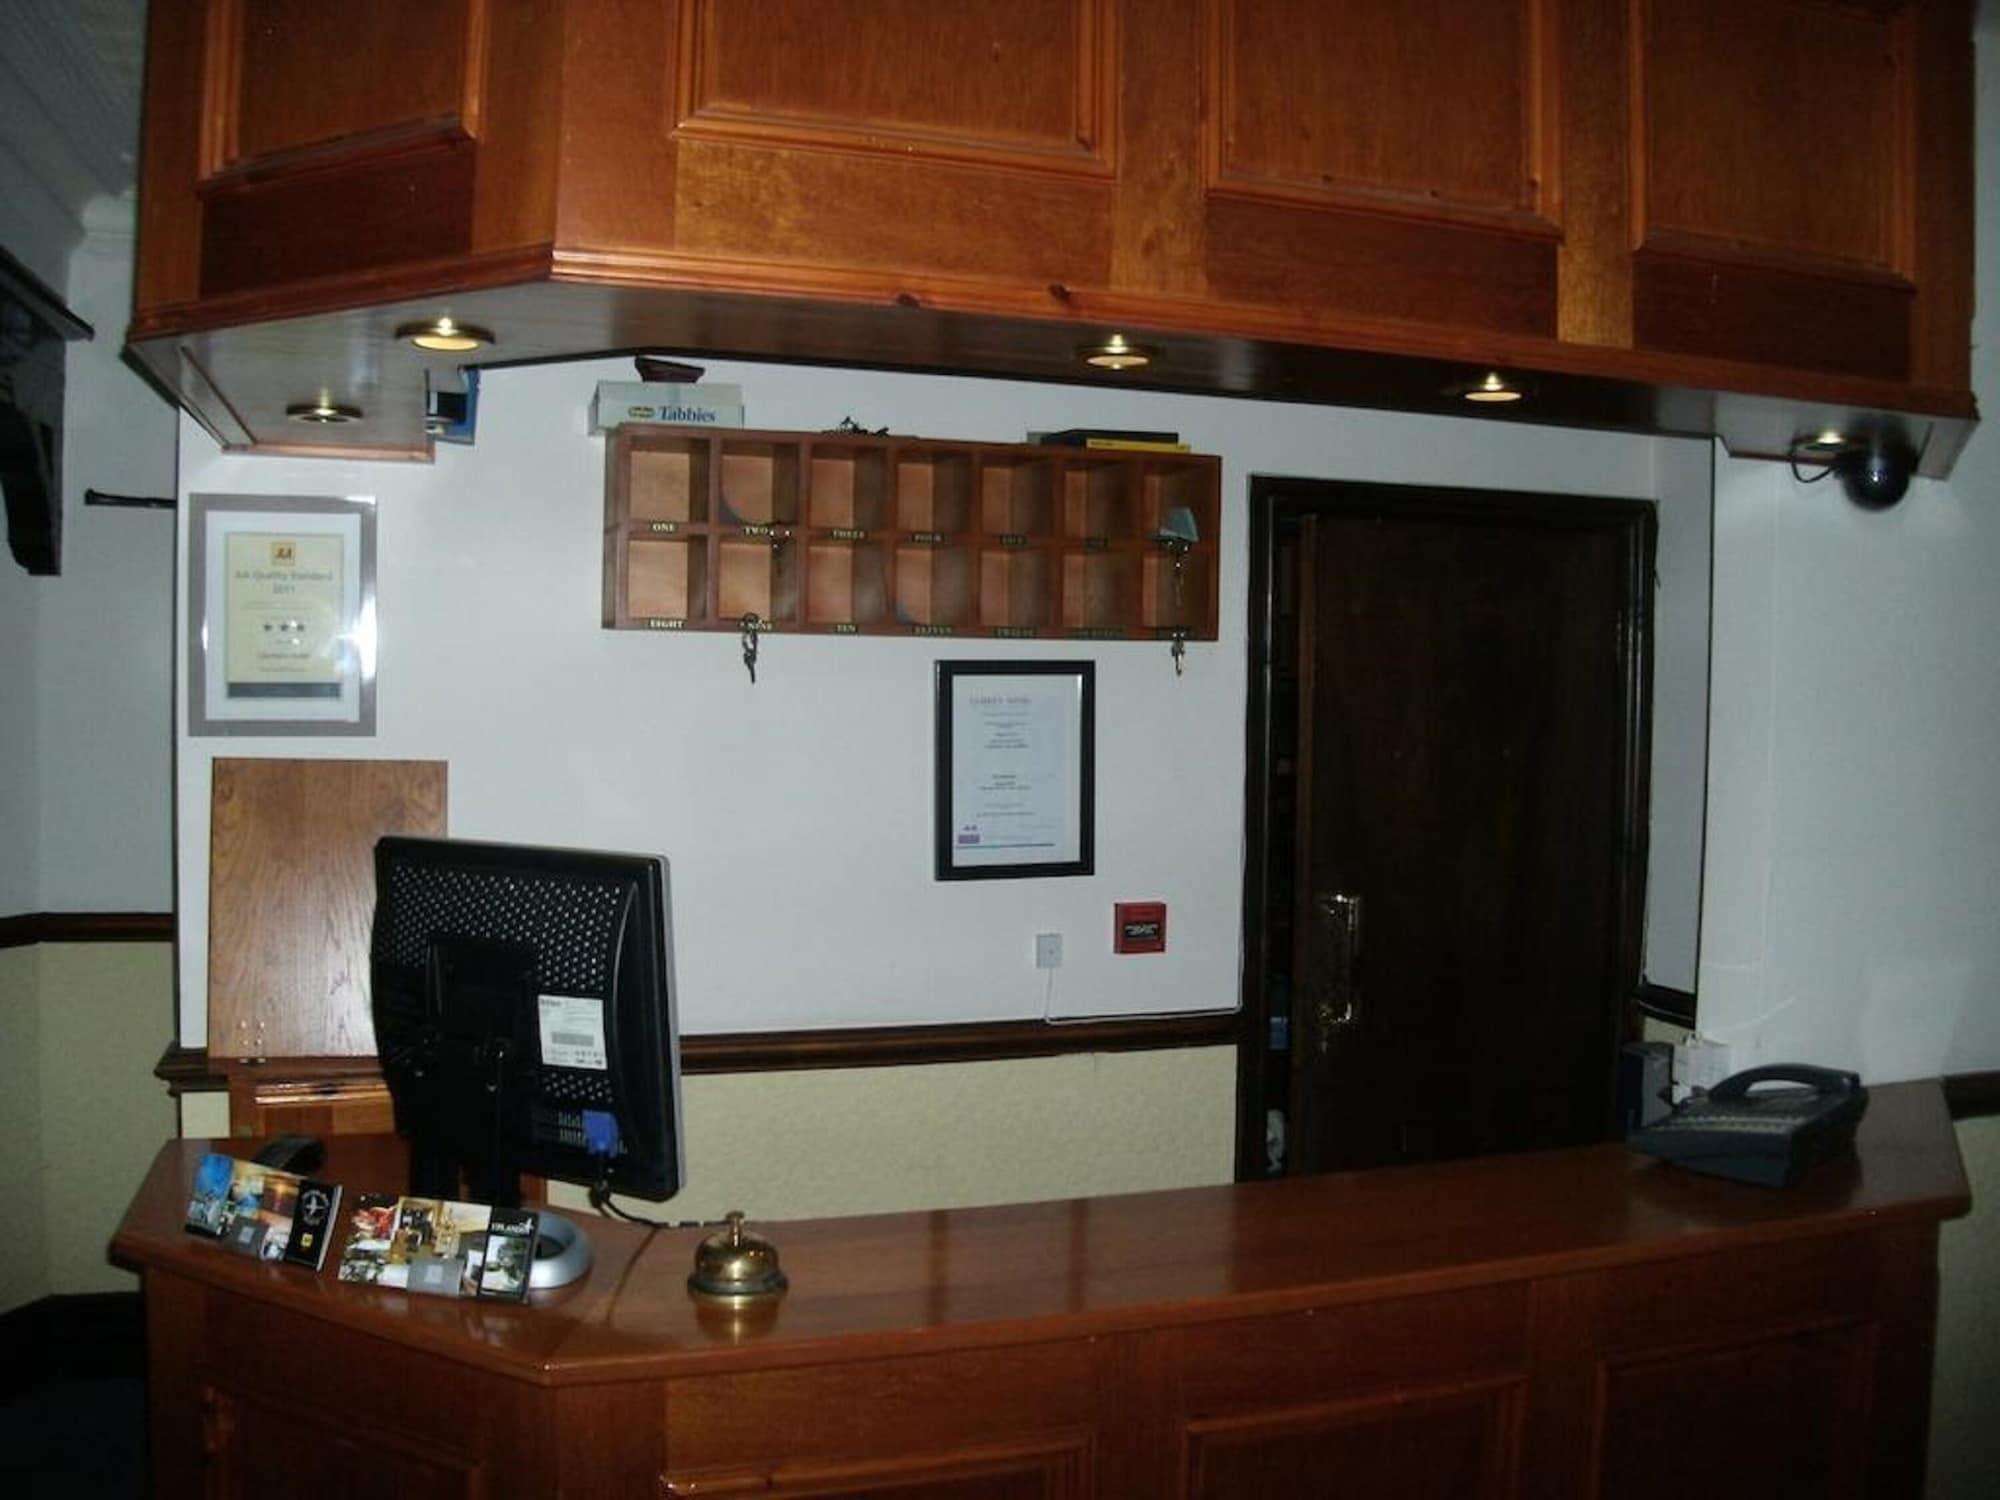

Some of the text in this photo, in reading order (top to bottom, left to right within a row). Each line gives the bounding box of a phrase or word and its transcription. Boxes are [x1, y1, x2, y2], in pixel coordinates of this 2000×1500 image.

[658, 405, 717, 422] Tabbies
[652, 522, 674, 532] ONE
[745, 525, 769, 535] TWO
[650, 619, 683, 629] EIGHT
